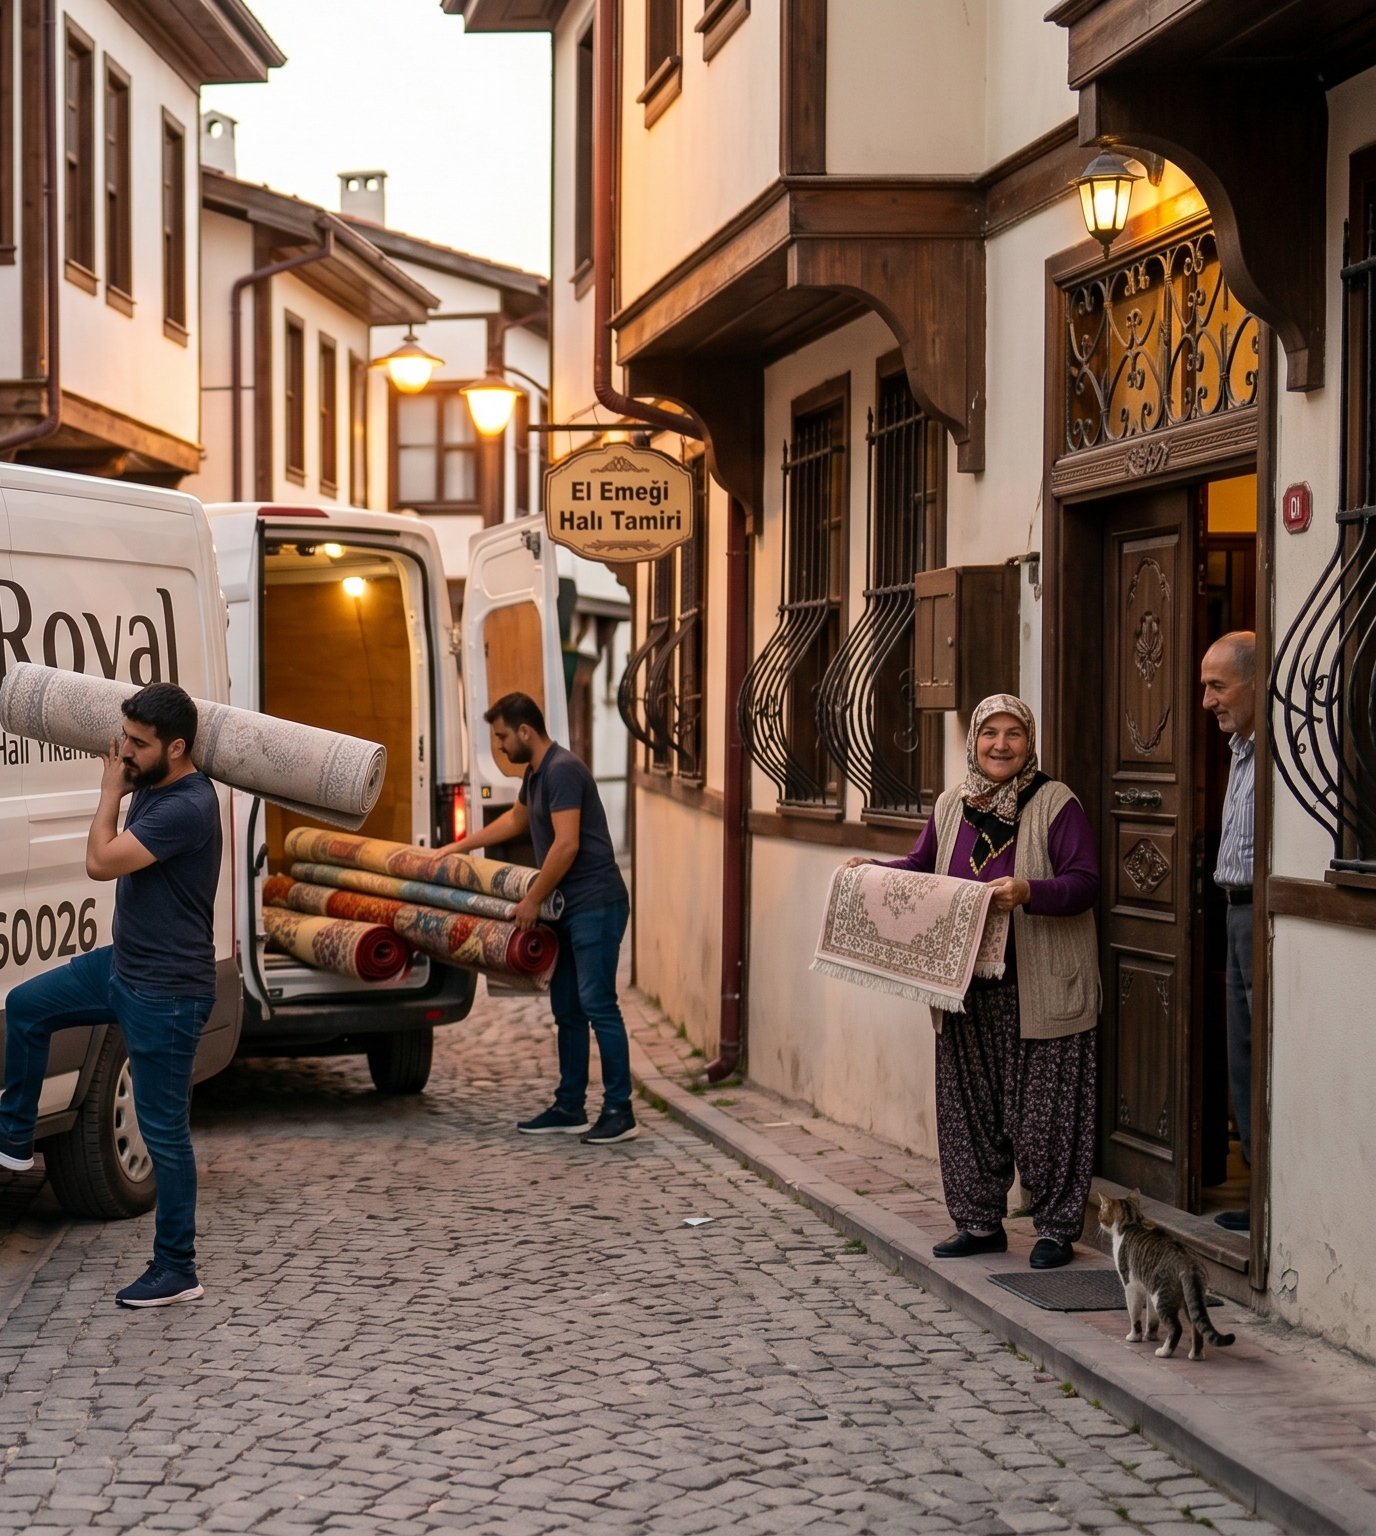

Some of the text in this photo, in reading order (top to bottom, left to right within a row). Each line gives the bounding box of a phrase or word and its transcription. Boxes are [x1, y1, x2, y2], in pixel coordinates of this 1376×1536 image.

[571, 480, 669, 506] El Emeği
[560, 510, 681, 530] Halı Tamiri
